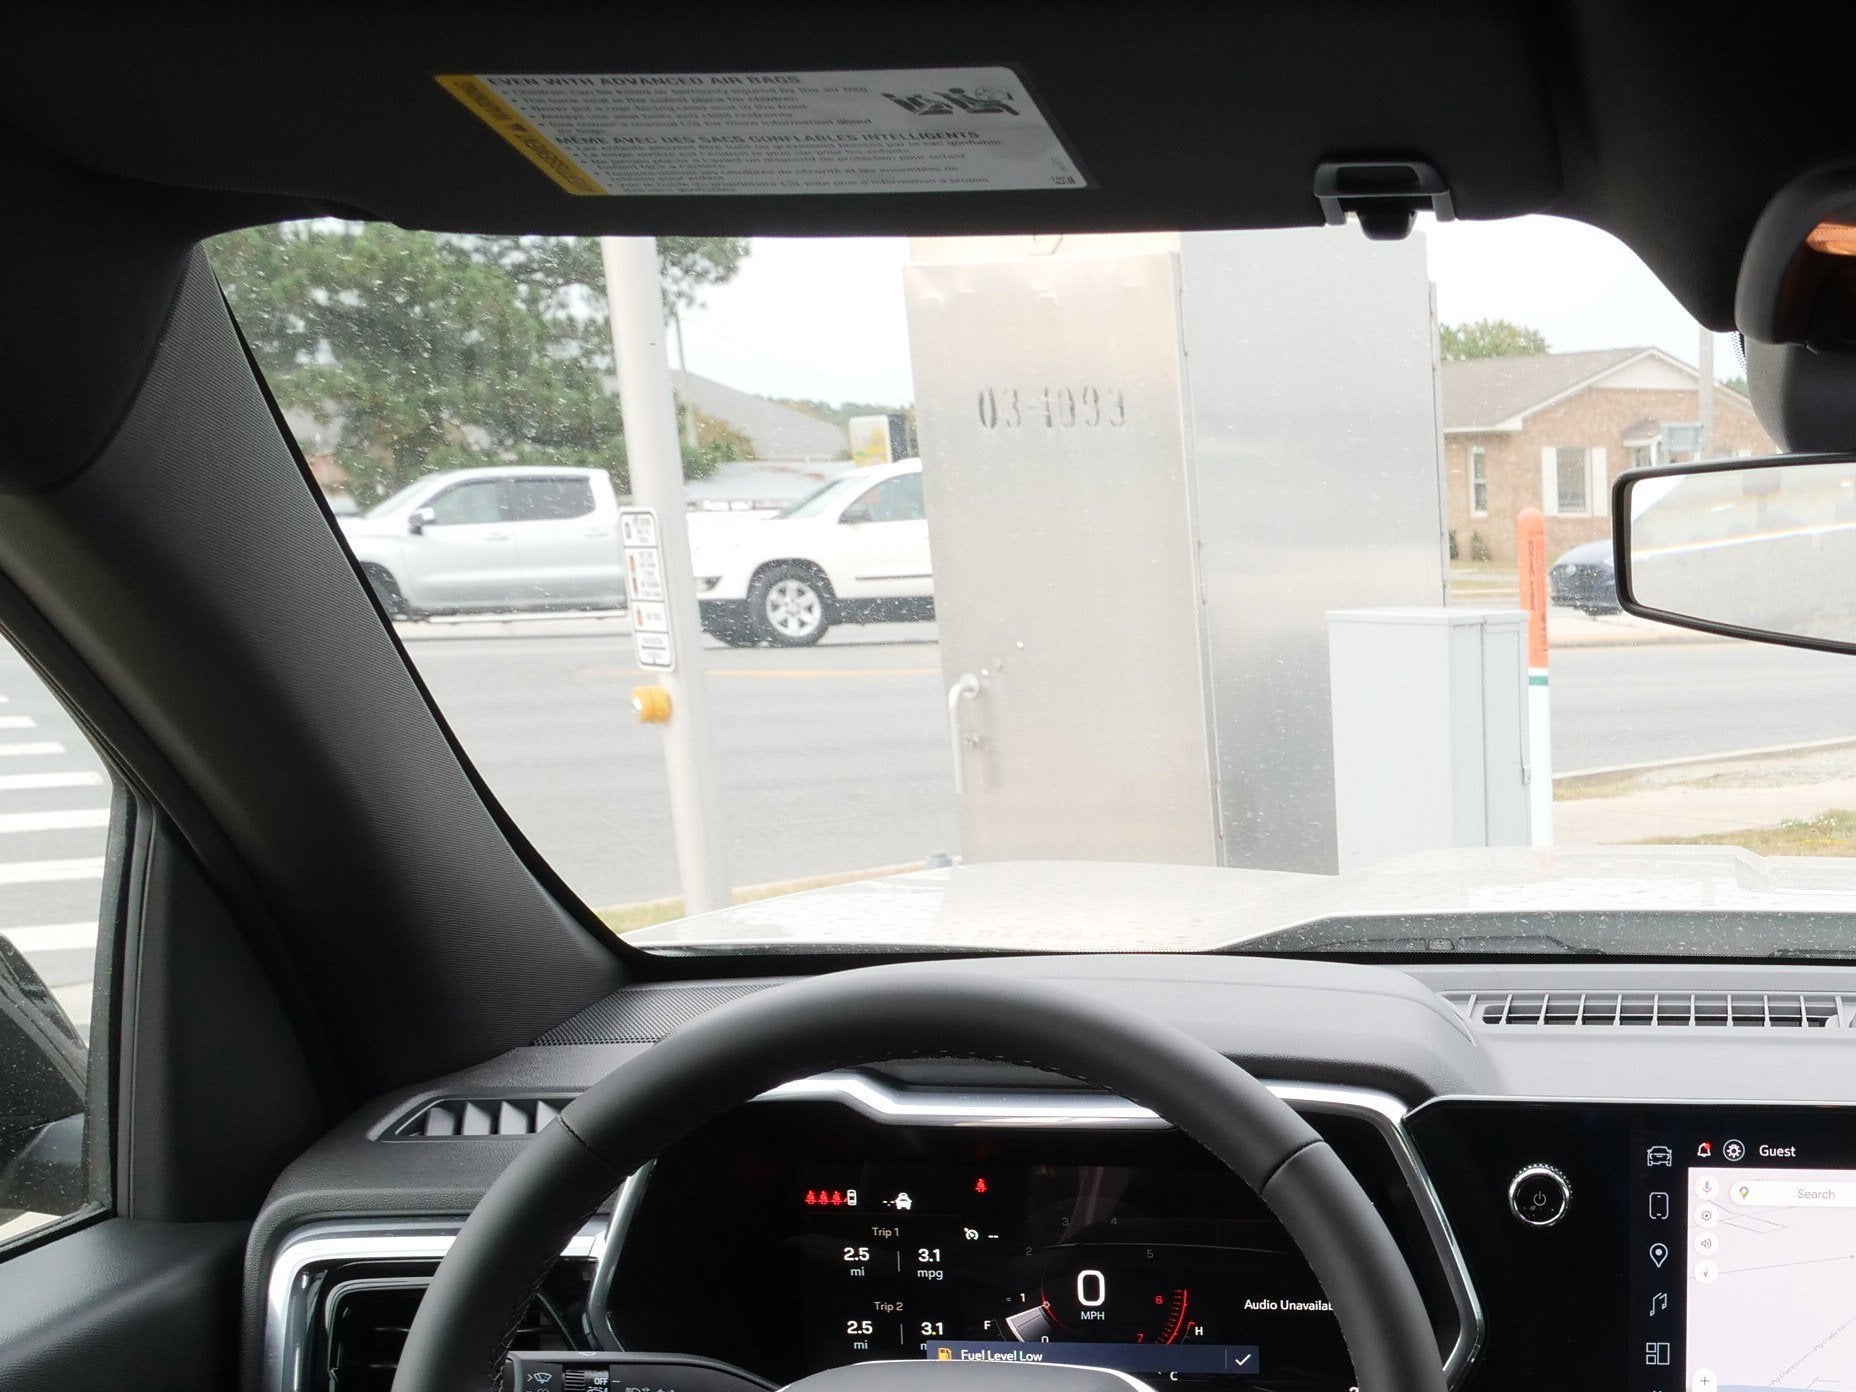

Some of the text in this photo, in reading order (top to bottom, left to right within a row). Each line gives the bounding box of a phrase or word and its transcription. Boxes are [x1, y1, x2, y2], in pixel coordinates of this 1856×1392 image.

[977, 385, 1126, 430] 03-1093
[1758, 1144, 1796, 1158] Guest
[1797, 1188, 1836, 1200] Search
[871, 1227, 892, 1238] Trip
[843, 1247, 870, 1261] 2.5
[918, 1248, 941, 1262] 3.1
[850, 1267, 865, 1277] mi
[917, 1268, 943, 1281] mpg
[1077, 1269, 1106, 1307] 0
[1154, 1296, 1163, 1305] 6
[1243, 1299, 1277, 1311] Audio
[874, 1302, 904, 1312] Trip 2
[1080, 1310, 1105, 1321] MPH
[846, 1321, 873, 1335] 2.5
[921, 1321, 943, 1336] 3.1
[983, 1320, 991, 1330] F
[1195, 1326, 1203, 1336] H
[1137, 1333, 1144, 1343] 7
[853, 1340, 868, 1350] mi
[960, 1350, 1043, 1363] Fuel Level Low
[594, 1377, 608, 1386] OFF
[1169, 1371, 1178, 1381] C
